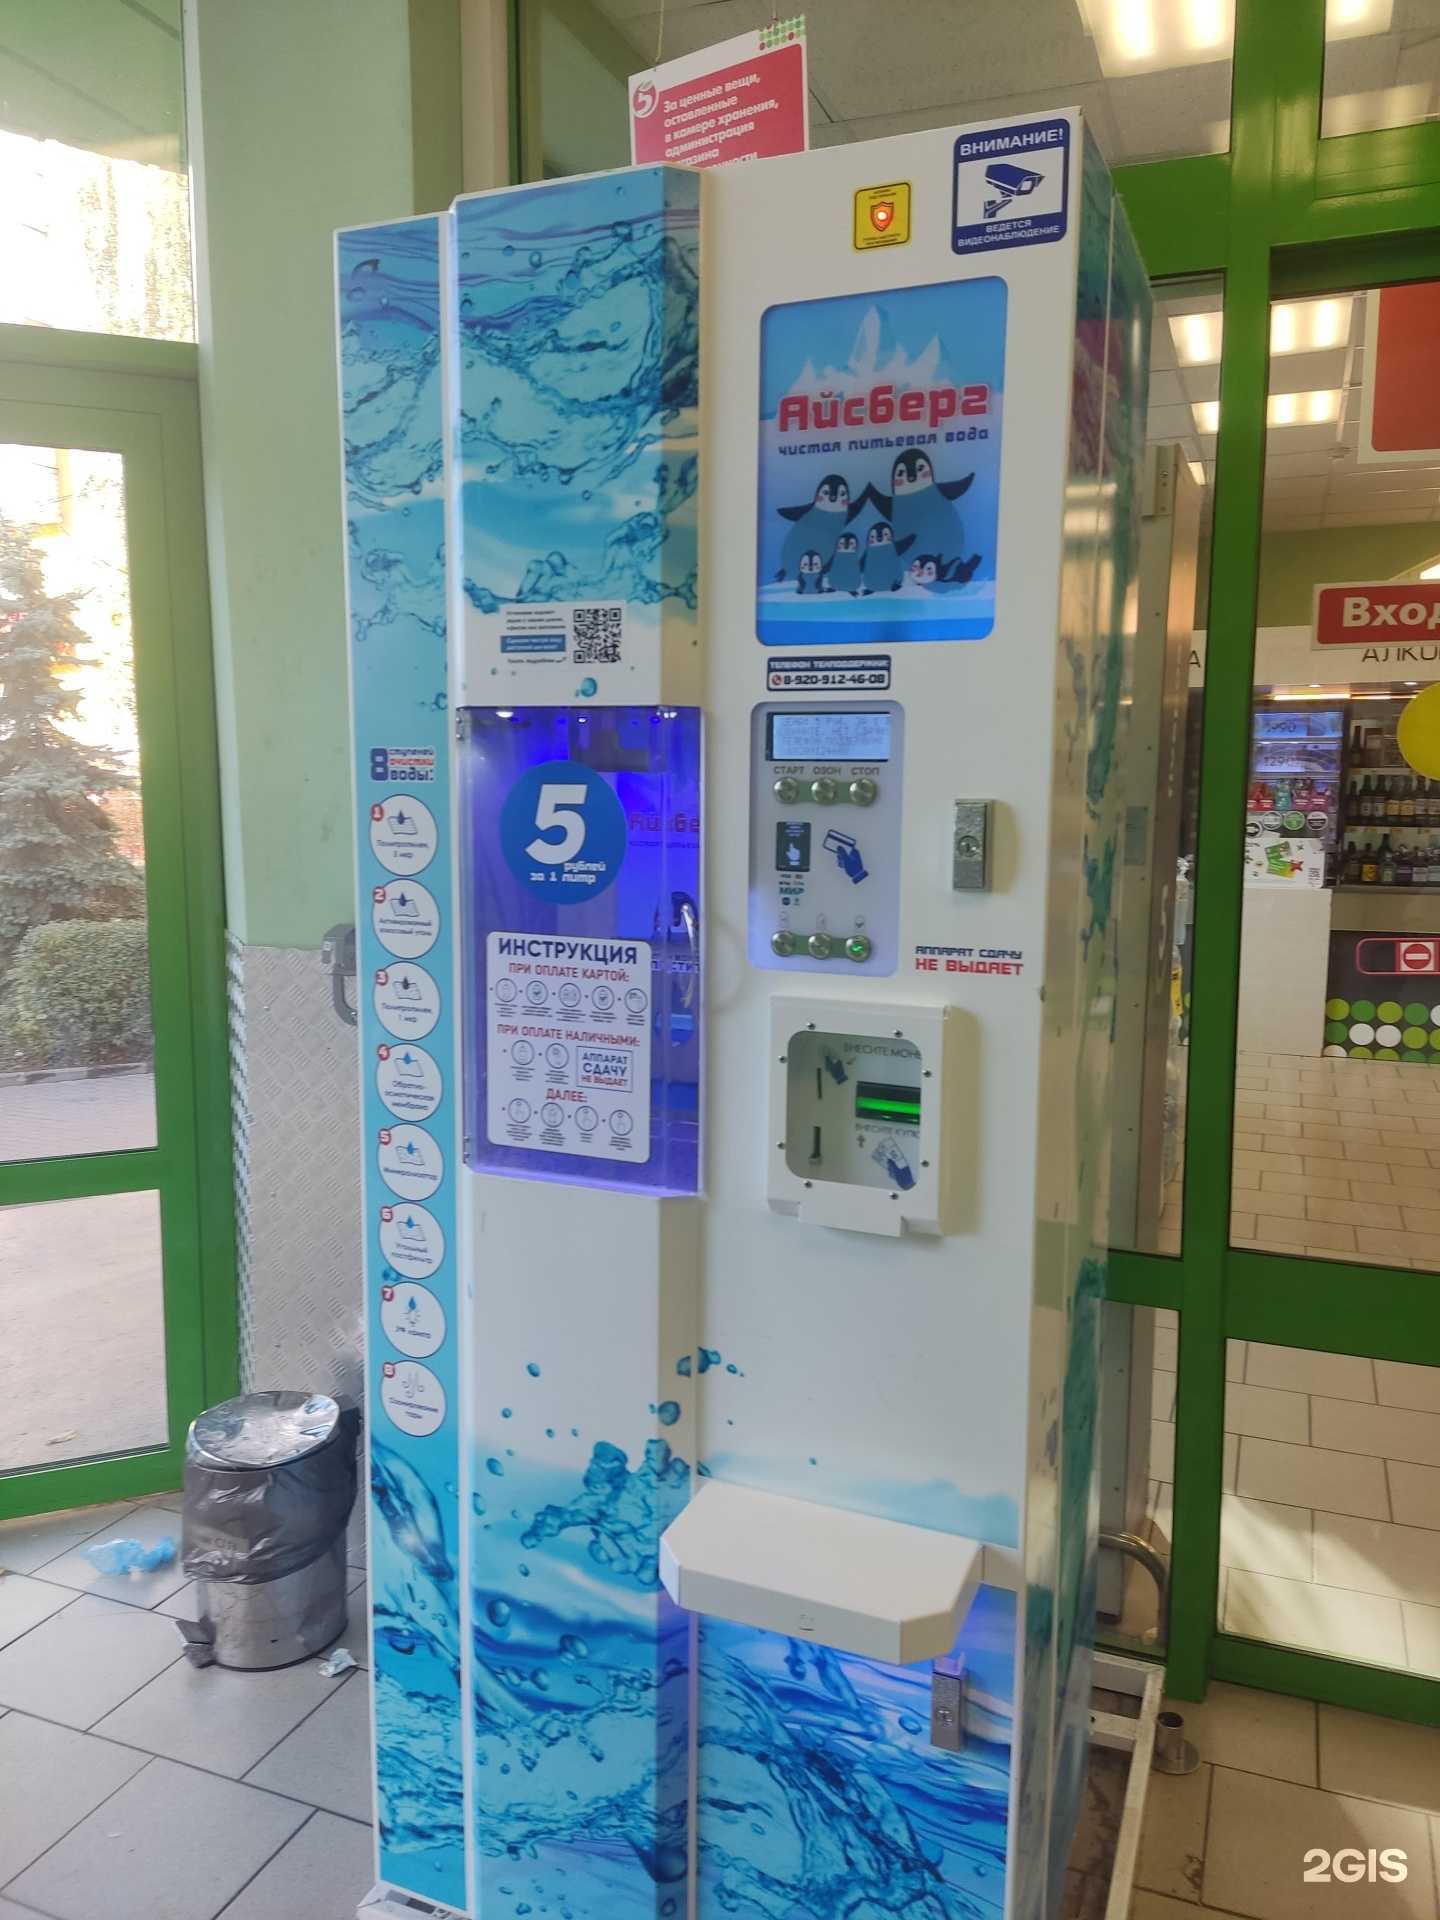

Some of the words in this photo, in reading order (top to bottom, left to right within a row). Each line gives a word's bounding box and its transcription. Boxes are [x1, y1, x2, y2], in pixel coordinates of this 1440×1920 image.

[663, 99, 678, 113] За
[679, 85, 723, 109] ценные
[664, 96, 738, 127] оставленные
[664, 132, 672, 143] в
[673, 120, 716, 139] камере
[665, 121, 755, 158] администрация
[960, 128, 1063, 156] ВНИМАНИЕ!
[985, 219, 1032, 233] ВЕДЕТСЯ
[957, 225, 1060, 247] ВИДЕОНАБЛЮДЕНИЕ
[778, 384, 988, 432] Айсберг
[778, 441, 841, 456] чистая
[848, 433, 937, 451] питьевая
[945, 426, 989, 443] вода
[371, 748, 388, 781] 8
[774, 766, 804, 774] СТАРТ
[851, 767, 880, 776] СТОП
[390, 767, 434, 781] воды:
[373, 806, 381, 819] 1
[525, 784, 588, 865] 5
[529, 872, 545, 881] за
[549, 872, 558, 881] 1
[561, 873, 597, 885] литр
[374, 888, 384, 901] 2
[498, 938, 637, 965] ИНСТРУКЦИЯ
[915, 946, 974, 957] АППАРАТ
[979, 948, 1023, 960] СДАЧУ
[509, 962, 531, 975] ПРИ
[536, 965, 579, 978] ОПЛАТЕ
[582, 968, 630, 982] КАРТОЙ:
[915, 958, 938, 971] НЕ
[945, 959, 1024, 976] ВЫДАЕТ
[376, 971, 386, 984] 3
[497, 1024, 519, 1035] ПРИ
[522, 1026, 562, 1040] ОПЛАТЕ
[566, 1031, 640, 1047] НАЛИЧНЫМИ:
[582, 1052, 628, 1065] АППАРАТ
[582, 1063, 628, 1077] СДАЧУ
[546, 1088, 588, 1102] ДАЛЕЕ:
[380, 1130, 390, 1143] 5
[383, 1287, 392, 1300] 7
